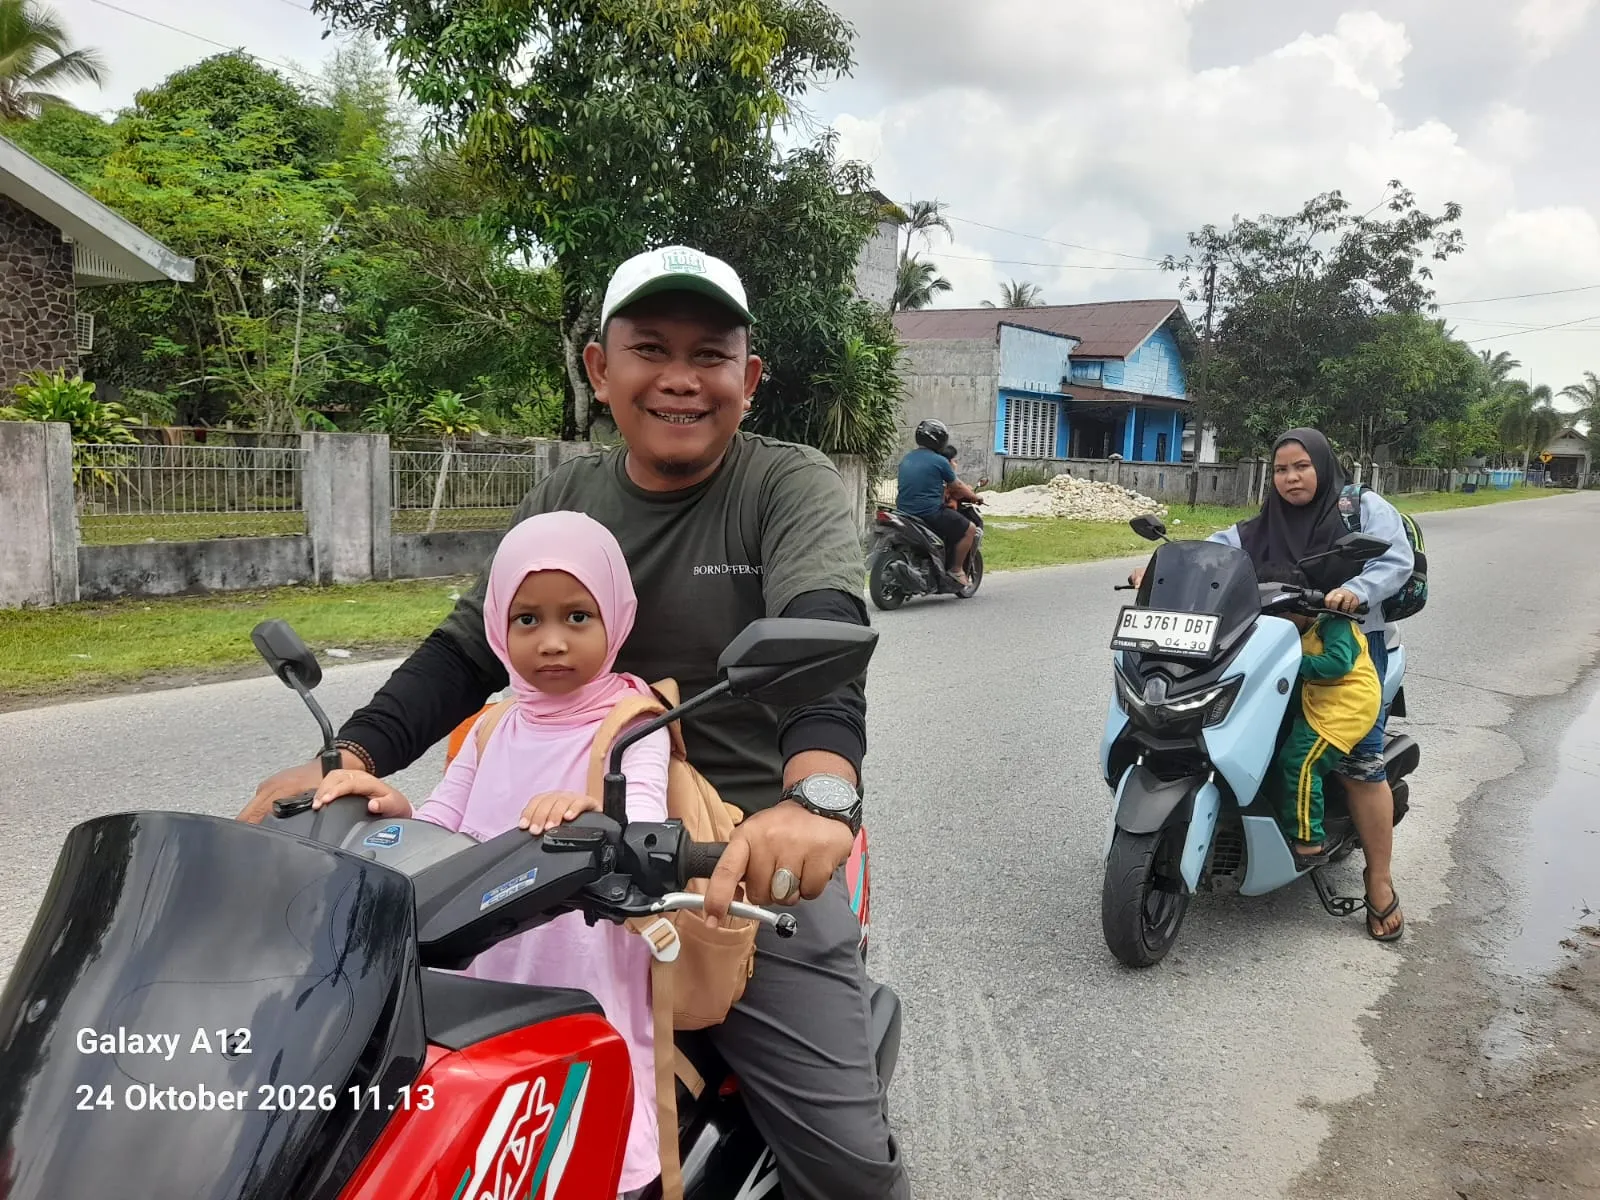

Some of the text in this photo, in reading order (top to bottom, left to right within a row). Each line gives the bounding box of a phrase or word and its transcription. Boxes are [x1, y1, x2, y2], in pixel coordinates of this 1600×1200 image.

[1123, 614, 1213, 635] BL 3761 DBT
